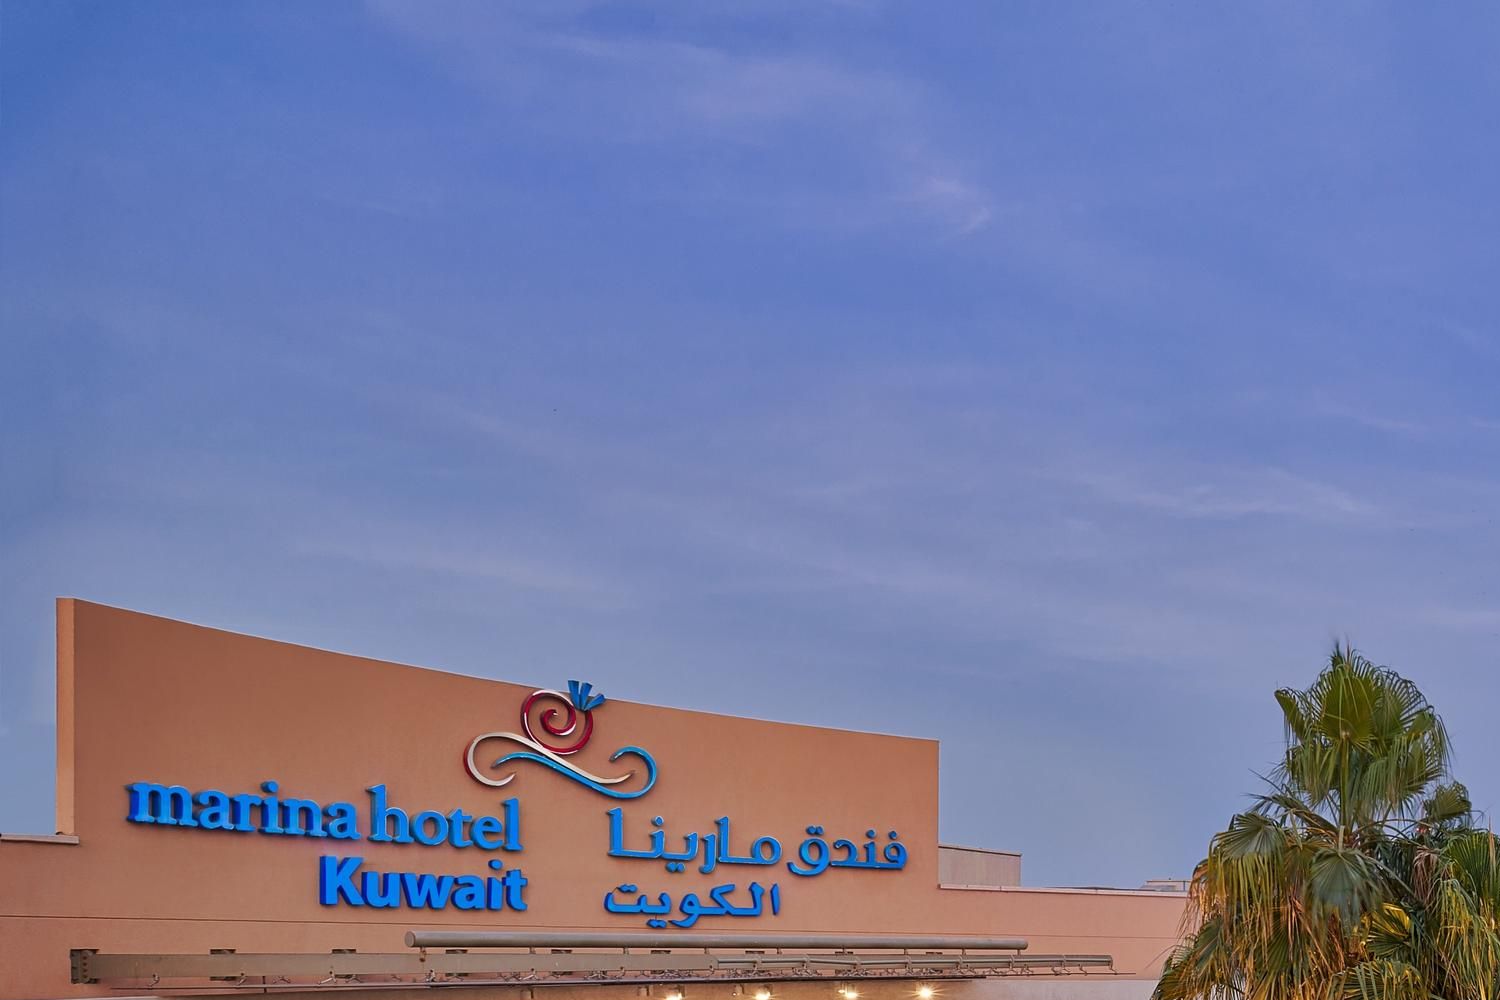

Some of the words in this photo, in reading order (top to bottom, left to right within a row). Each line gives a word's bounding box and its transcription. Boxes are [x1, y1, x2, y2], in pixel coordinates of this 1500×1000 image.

[125, 780, 361, 841] marina
[367, 784, 523, 851] hotel
[606, 807, 782, 874] مارينا
[786, 825, 908, 877] فندق
[319, 855, 528, 911] Kuwait
[603, 881, 781, 928] الكويت
